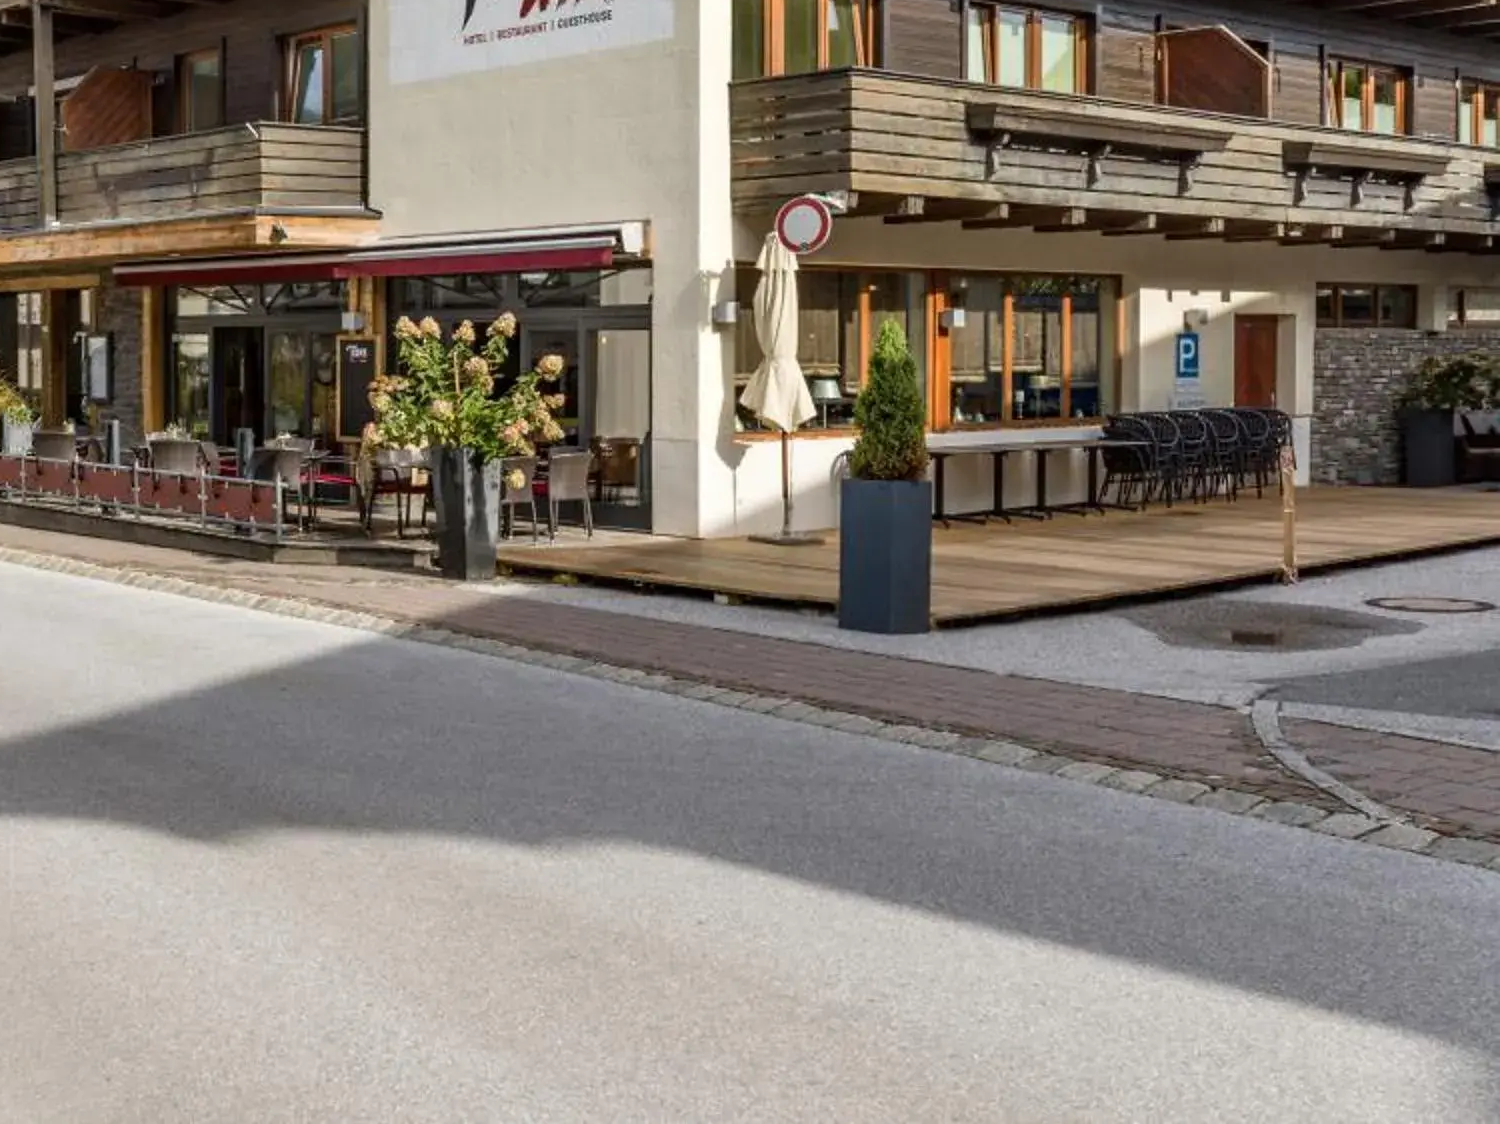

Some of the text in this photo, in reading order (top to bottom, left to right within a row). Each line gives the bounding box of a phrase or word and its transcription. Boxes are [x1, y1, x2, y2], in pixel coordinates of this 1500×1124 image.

[463, 32, 488, 45] HOTEL
[497, 21, 548, 40] RESTAURANT
[557, 9, 613, 29] GUESTHOUSE
[1180, 338, 1196, 372] P
